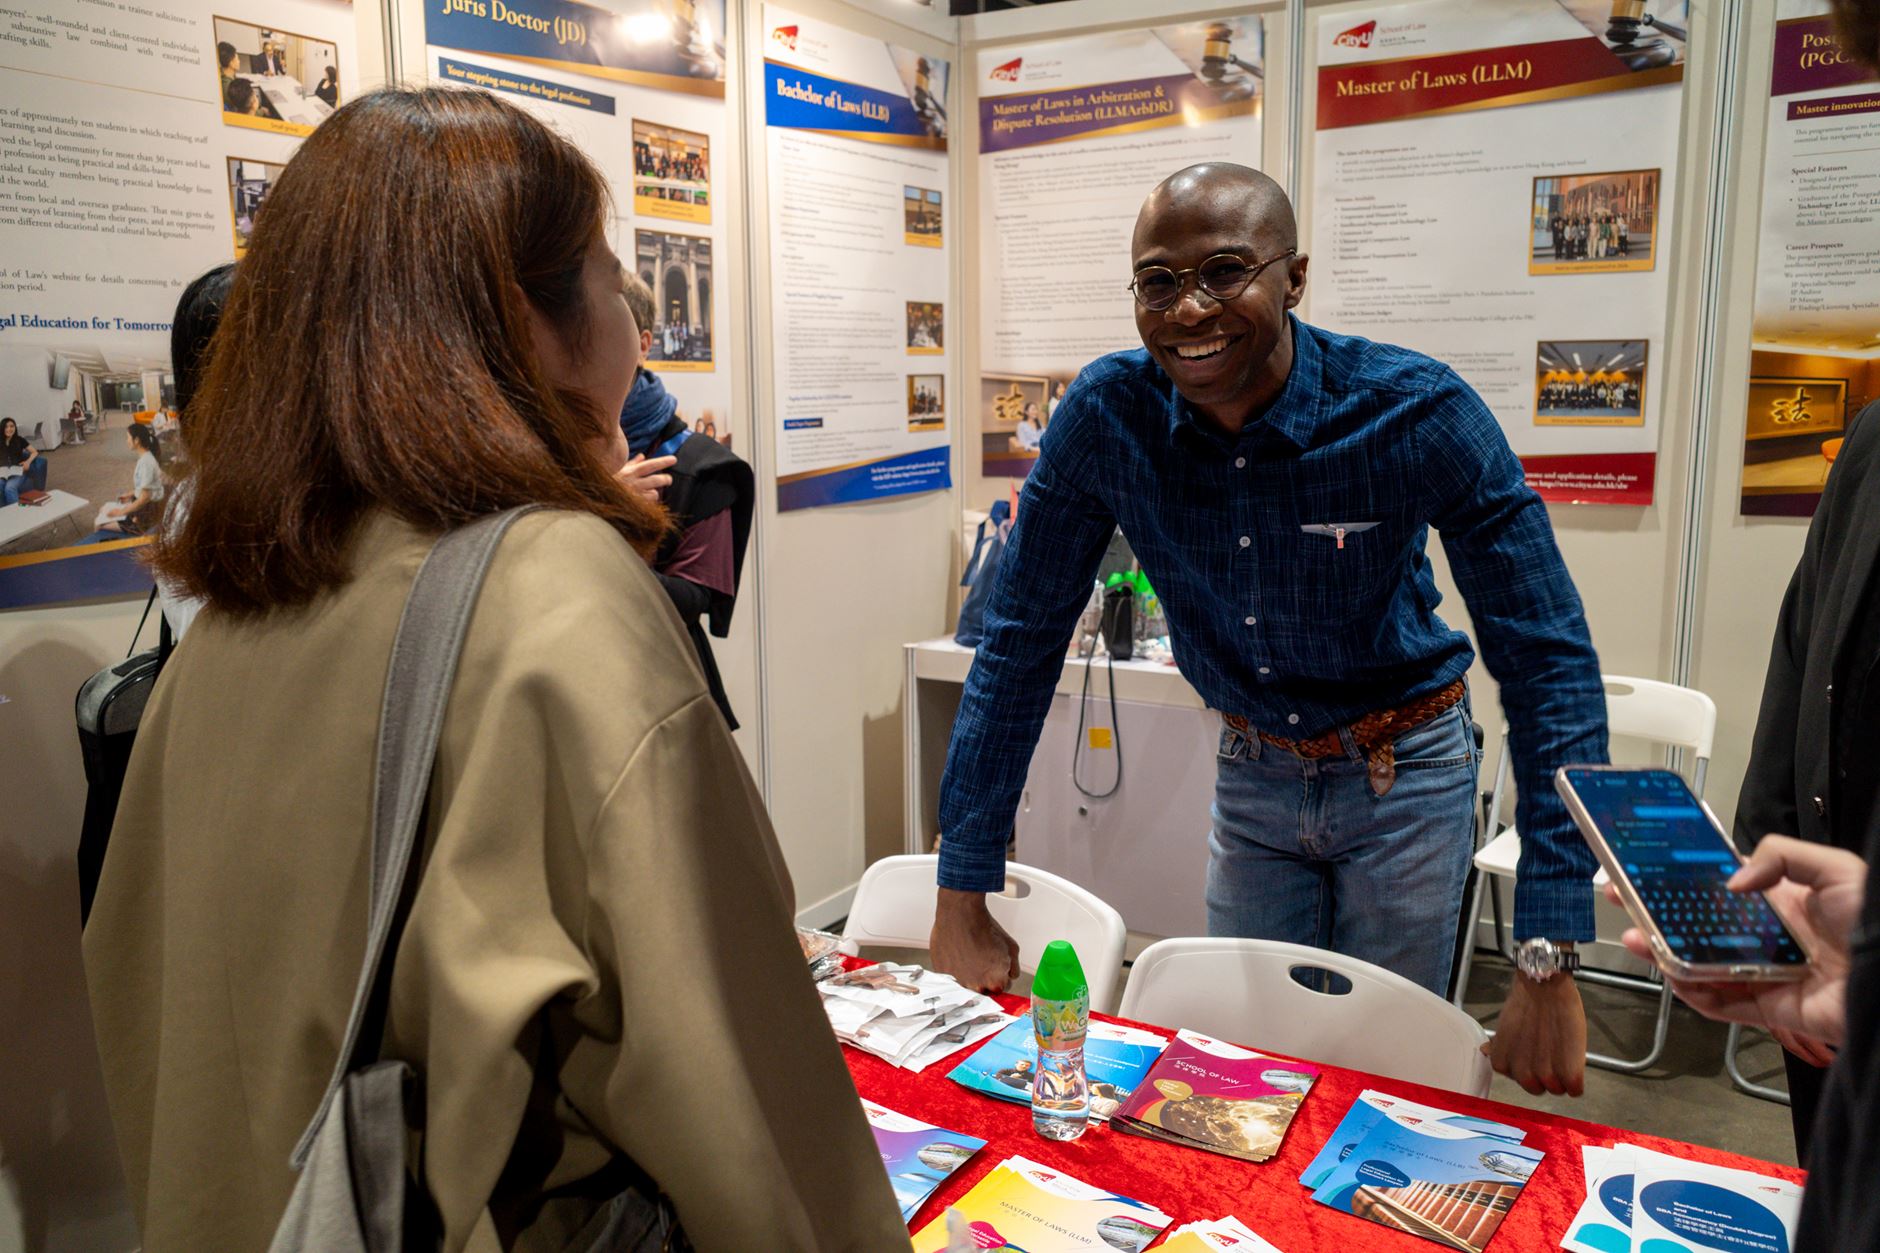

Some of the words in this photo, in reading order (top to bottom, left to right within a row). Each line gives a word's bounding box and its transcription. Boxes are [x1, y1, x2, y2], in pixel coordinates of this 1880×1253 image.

[128, 5, 153, 16] trainee
[155, 10, 187, 24] solicitors
[492, 0, 550, 34] Doctor
[554, 15, 587, 46] (JD)
[10, 21, 56, 37] substantive
[65, 31, 80, 42] law
[89, 39, 128, 51] combined
[136, 47, 154, 56] with
[161, 53, 200, 65] exceptional
[28, 36, 52, 48] skills.
[36, 15, 89, 31] well-rounded
[108, 28, 160, 46] client-centred
[161, 40, 200, 54] individuals
[1336, 80, 1395, 97] Master
[1399, 70, 1420, 91] of
[1423, 72, 1467, 89] Laws
[1472, 59, 1532, 85] (LLM)
[541, 85, 558, 99] legal
[777, 78, 823, 105] Bachelor
[824, 91, 838, 108] of
[837, 94, 861, 115] Laws
[862, 100, 889, 123] (LLB)
[993, 104, 1028, 115] Master
[1030, 97, 1044, 111] of
[1044, 98, 1072, 110] Laws
[1073, 95, 1085, 106] in
[1087, 88, 1151, 105] Arbitration
[1154, 85, 1165, 98] &
[992, 118, 1033, 134] Dispute
[1035, 111, 1093, 127] Resolution
[1094, 100, 1174, 121] (LLMArbDR)
[1796, 105, 1828, 115] Master
[0, 118, 36, 134] learning
[54, 126, 96, 140] discussion.
[9, 107, 20, 117] of
[21, 112, 78, 127] approximately
[80, 120, 94, 128] ten
[95, 121, 128, 132] students
[128, 125, 138, 134] in
[139, 127, 162, 137] which
[162, 131, 193, 144] teaching
[33, 138, 53, 151] legal
[54, 144, 100, 157] community
[101, 147, 113, 157] for
[115, 151, 135, 160] more
[136, 152, 154, 162] than
[3, 148, 46, 160] profession
[57, 153, 81, 167] being
[81, 159, 114, 168] practical
[131, 163, 174, 176] skills-based.
[1791, 166, 1817, 176] Special
[22, 178, 49, 188] world.
[27, 165, 55, 178] faculty
[59, 171, 95, 181] members
[98, 173, 120, 186] bring
[122, 179, 154, 188] practical
[156, 180, 193, 194] knowledge
[14, 191, 36, 202] from
[38, 193, 58, 204] local
[78, 200, 109, 209] overseas
[111, 202, 148, 213] graduates.
[150, 205, 168, 215] That
[20, 207, 41, 216] ways
[42, 206, 52, 216] of
[52, 207, 86, 221] learning
[87, 210, 106, 220] from
[108, 212, 126, 222] their
[1798, 202, 1833, 210] Technology
[17, 216, 52, 227] different
[53, 220, 99, 231] educational
[116, 225, 145, 236] cultural
[1810, 242, 1844, 250] Prospects
[11, 269, 21, 278] of
[24, 269, 48, 279] Law's
[84, 273, 96, 282] for
[100, 274, 124, 284] details
[16, 282, 46, 293] period.
[20, 314, 88, 329] Education
[91, 316, 110, 329] for
[1175, 1059, 1208, 1075] SCHOOL
[1209, 1071, 1219, 1079] OF
[1220, 1075, 1241, 1085] LAW
[999, 1201, 1032, 1219] MASTER
[1032, 1215, 1044, 1225] OF
[1044, 1219, 1068, 1236] LAWS
[1069, 1227, 1093, 1245] (LLM)
